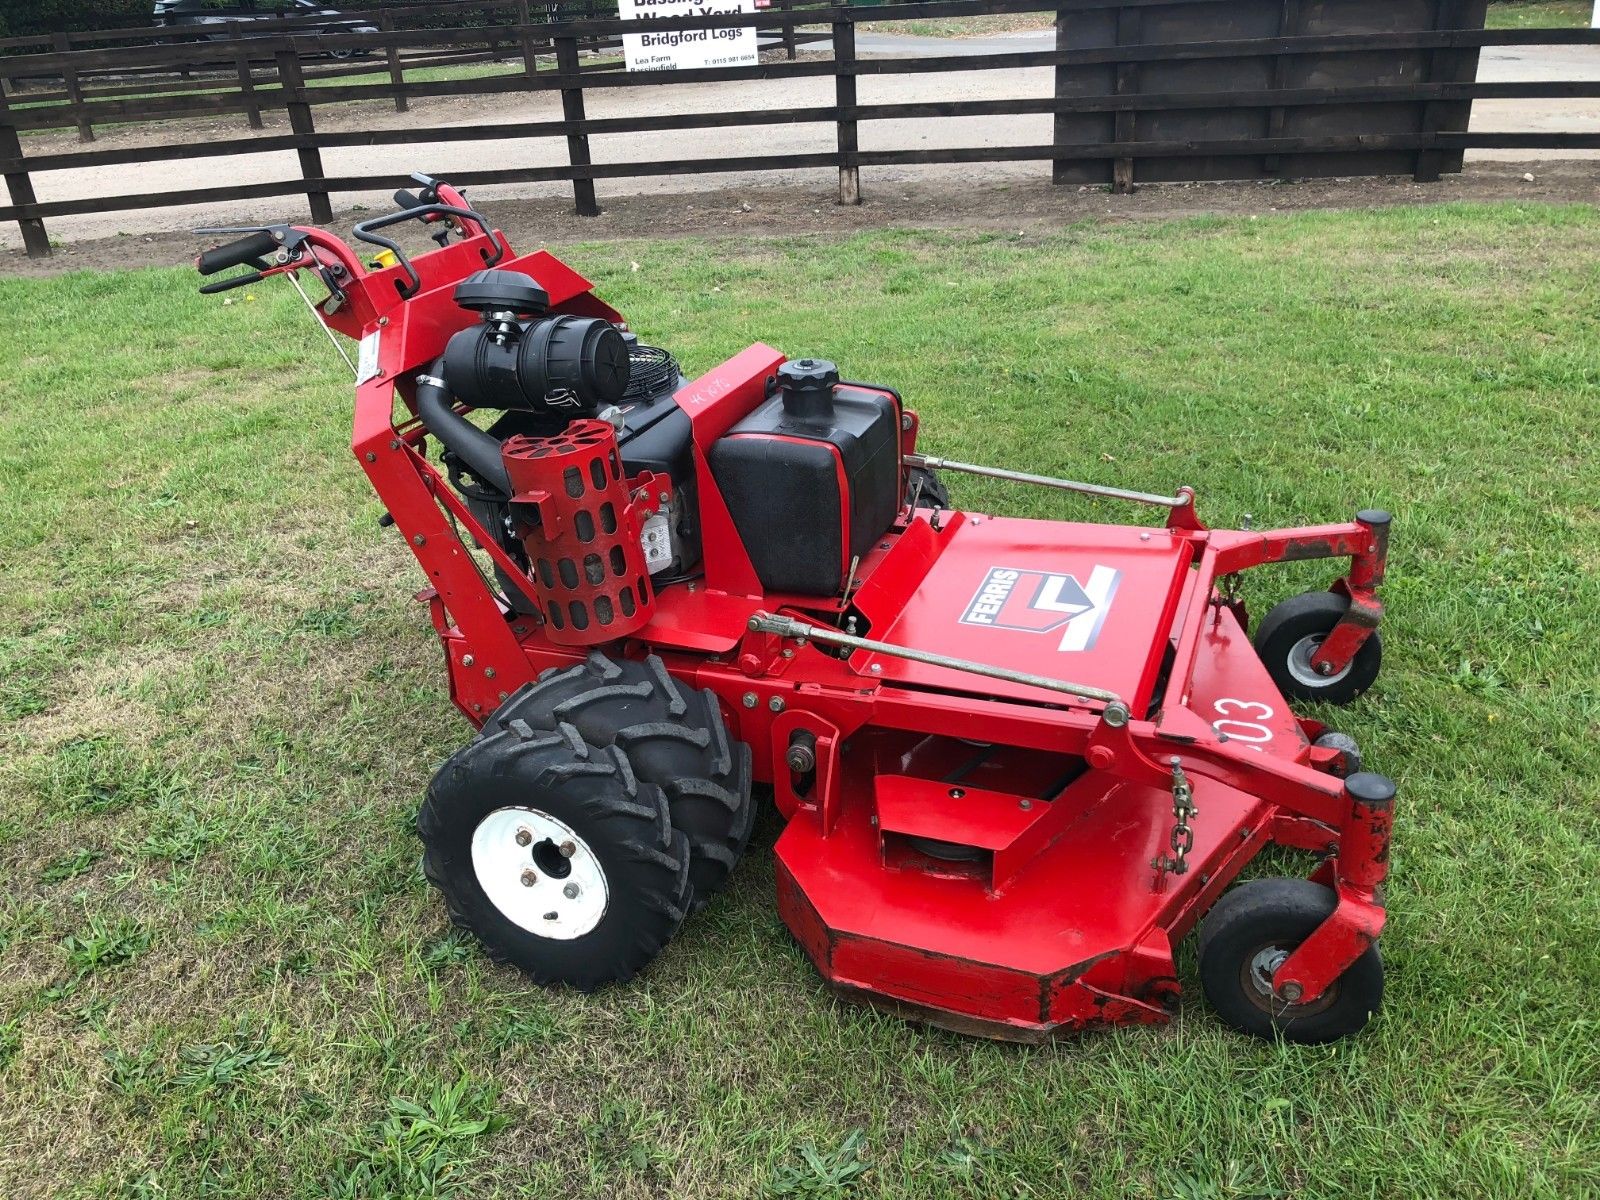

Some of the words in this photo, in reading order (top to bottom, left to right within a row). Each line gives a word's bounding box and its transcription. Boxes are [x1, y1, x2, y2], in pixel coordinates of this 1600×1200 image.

[641, 30, 707, 47] Bridgford
[712, 28, 743, 41] Logs
[651, 55, 671, 63] Farm
[966, 569, 1019, 624] FERRIS
